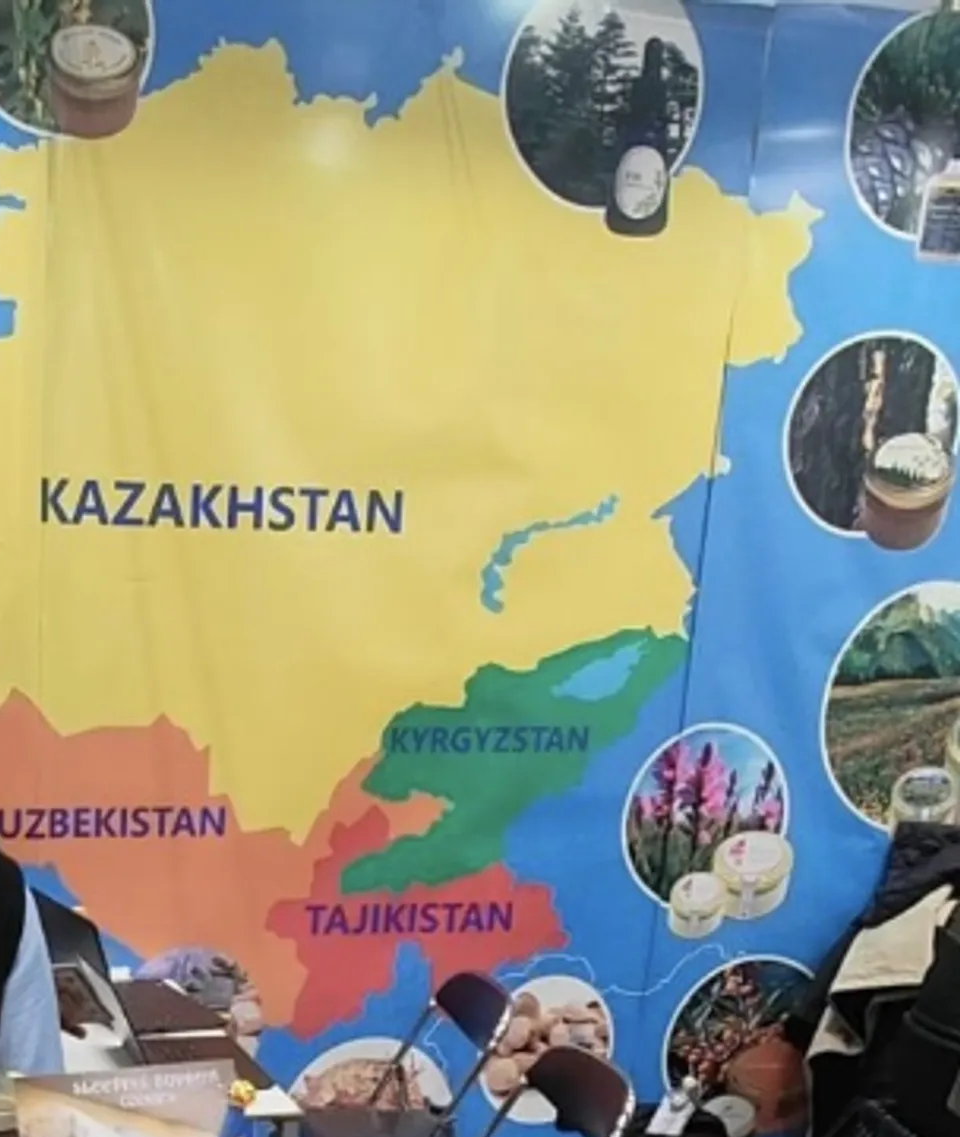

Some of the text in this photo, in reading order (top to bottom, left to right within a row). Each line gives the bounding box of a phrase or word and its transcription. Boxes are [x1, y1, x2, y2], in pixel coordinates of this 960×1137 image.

[40, 477, 404, 533] KAZAKHSTAN
[390, 726, 590, 755] KYRGYZSTAN
[305, 902, 514, 936] TAJIKISTAN
